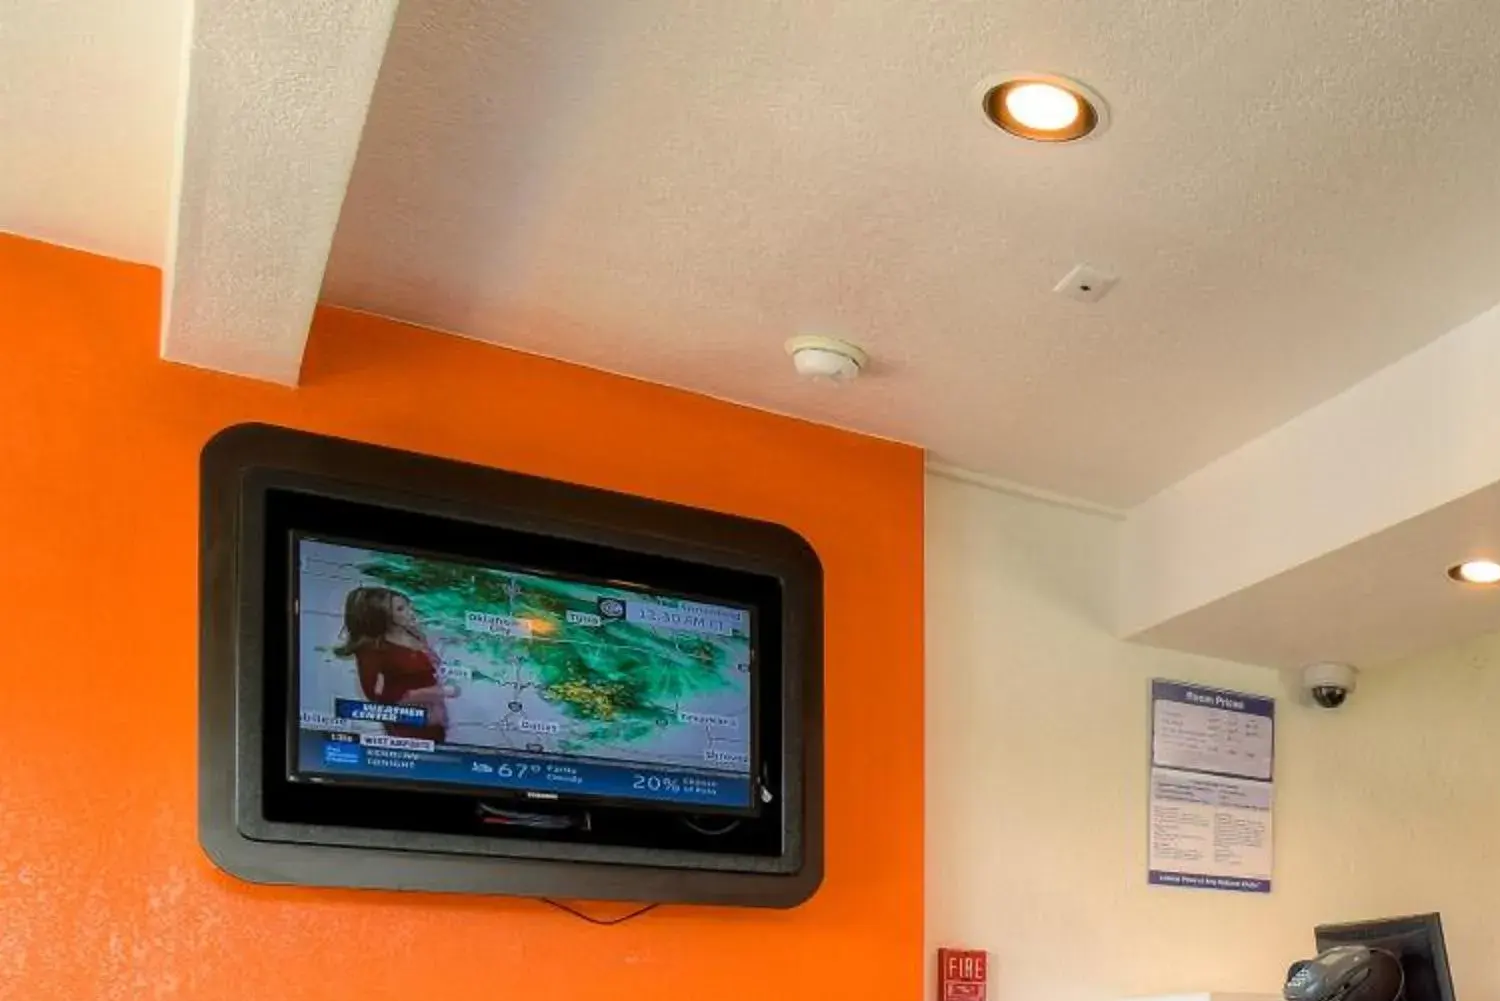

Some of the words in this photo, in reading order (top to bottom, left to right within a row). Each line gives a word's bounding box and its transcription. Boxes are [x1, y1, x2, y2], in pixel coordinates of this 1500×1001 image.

[363, 703, 425, 717] WEATHER
[633, 775, 680, 793] 20%
[949, 957, 983, 979] FIRE
